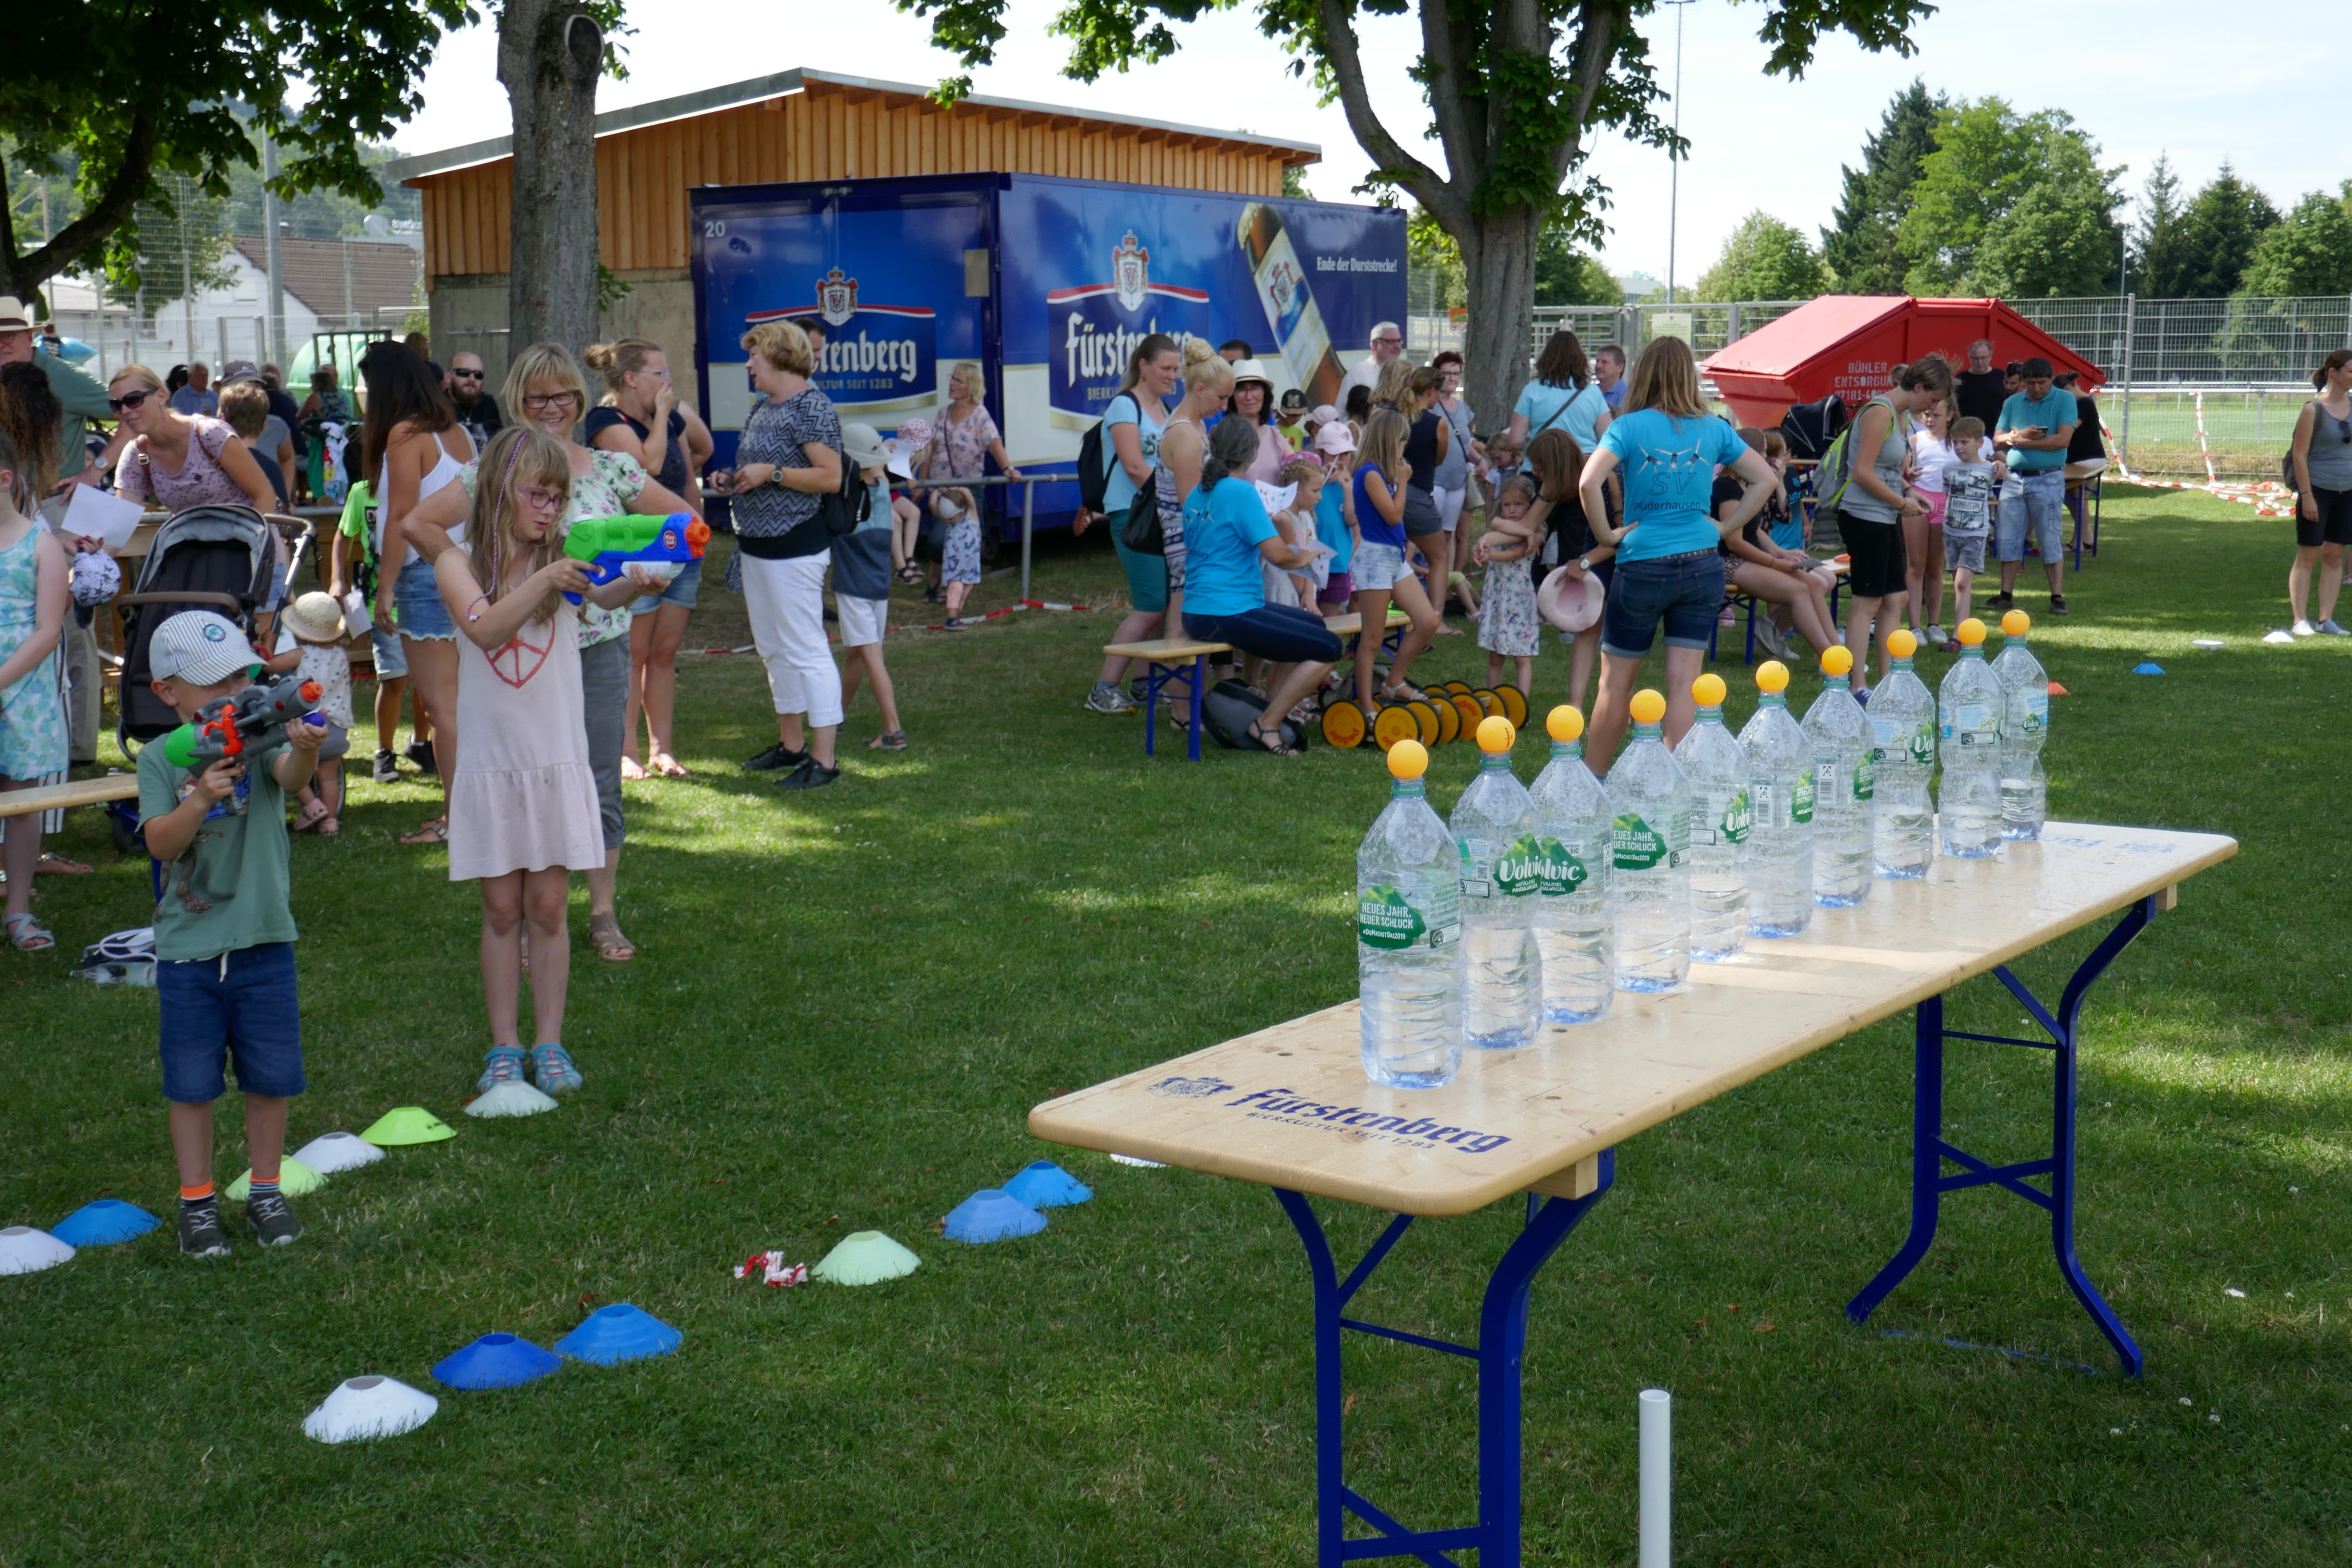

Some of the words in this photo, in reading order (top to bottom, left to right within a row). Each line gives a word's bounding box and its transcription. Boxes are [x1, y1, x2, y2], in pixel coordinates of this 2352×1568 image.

[705, 221, 726, 237] 20
[1317, 257, 1336, 271] Ende
[1337, 257, 1350, 271] der
[1350, 257, 1397, 273] Durststrecke!
[1848, 361, 1887, 374] BÜHLER
[846, 379, 867, 389] SEIT
[869, 378, 893, 389] 1283
[1835, 376, 1893, 387] ENTSORGUN
[1650, 472, 1697, 496] SV
[1633, 501, 1700, 511] Plüderhausen
[1613, 830, 1632, 840] EUES
[1632, 831, 1655, 842] JAHR,
[1614, 841, 1626, 849] UER
[1627, 842, 1657, 851] SCHLUCK
[1362, 902, 1385, 915] NEUES
[1386, 905, 1412, 918] JAHR,
[1360, 913, 1380, 925] NEUER
[1381, 916, 1413, 929] SCHLUCK
[1246, 1112, 1347, 1133] BIERKULTUR
[1351, 1130, 1391, 1140] SEIT
[1391, 1137, 1436, 1149] 1283
